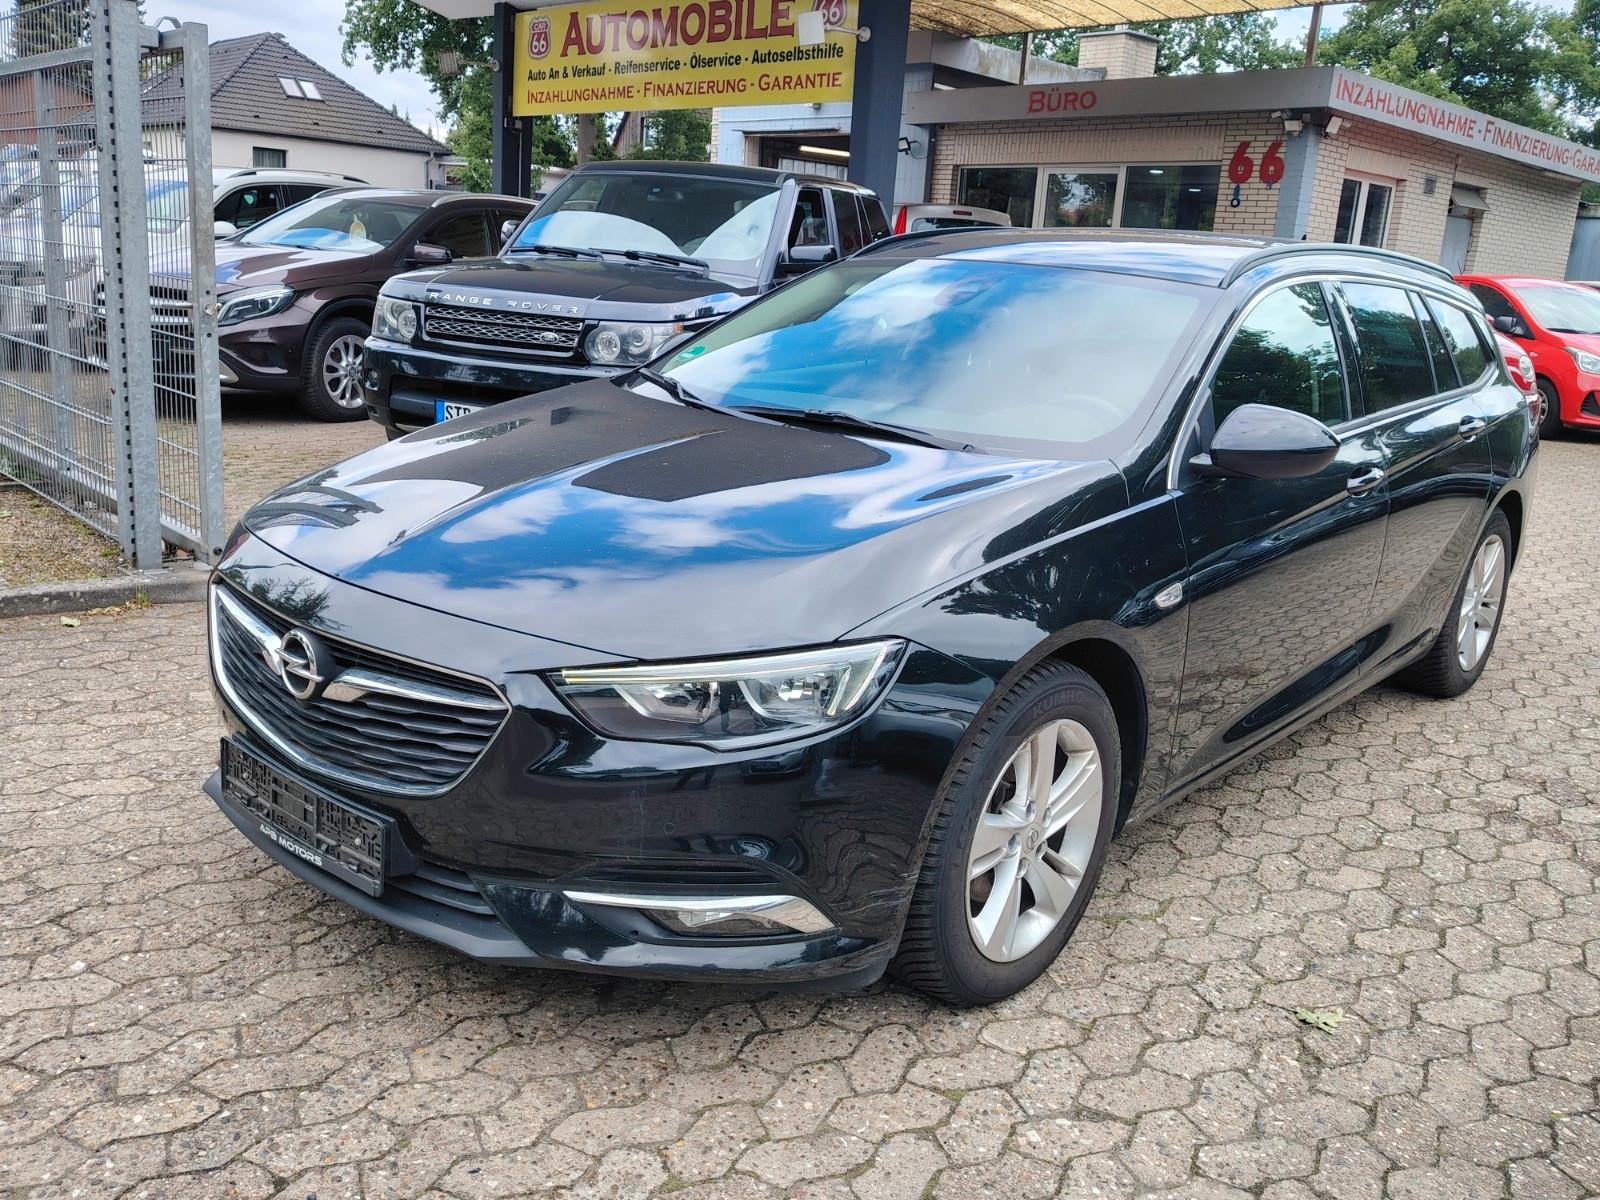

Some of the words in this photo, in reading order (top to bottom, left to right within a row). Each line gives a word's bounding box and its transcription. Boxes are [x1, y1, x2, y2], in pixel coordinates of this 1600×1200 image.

[533, 22, 547, 31] CAR
[560, 0, 795, 57] AUTOMOBILE
[531, 34, 547, 52] 66
[528, 69, 547, 81] Auto
[549, 67, 560, 79] An
[562, 67, 569, 79] &
[572, 63, 606, 77] Verkauf
[614, 58, 681, 74] Reifenservice
[690, 52, 741, 69] Ölservice
[752, 43, 844, 64] Autoselbsthilfe
[527, 86, 634, 104] INZAHLUNGNAHME
[643, 78, 747, 98] FINANZIERUNG
[758, 72, 842, 91] GARANTIE
[1027, 87, 1097, 113] BÜRO
[1335, 74, 1476, 139] INZAHLUNGNAHME
[1228, 140, 1285, 184] 66
[429, 292, 493, 306] RANGE
[507, 299, 578, 314] ROVER
[279, 836, 322, 866] MOTORS
